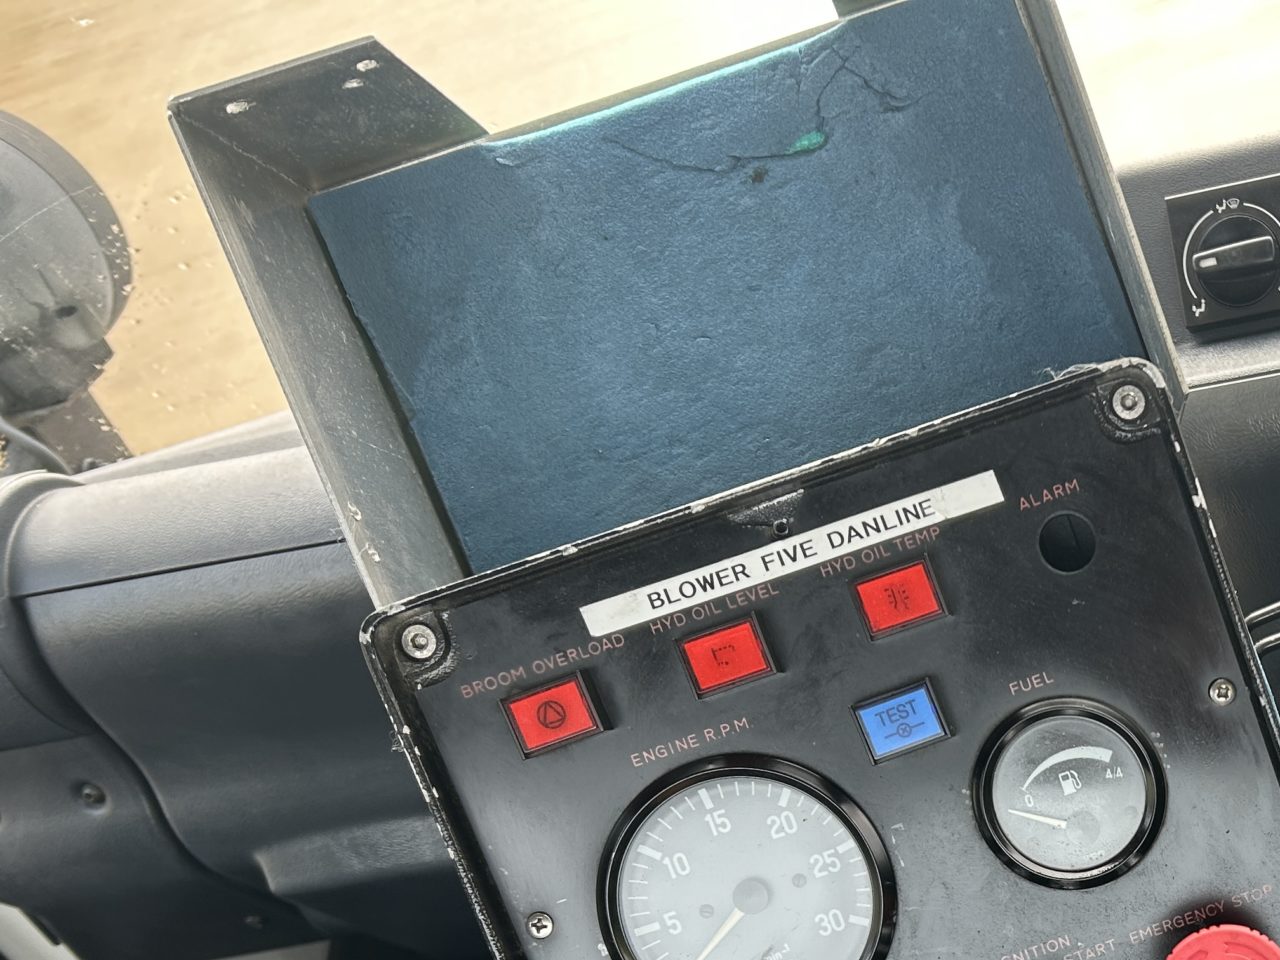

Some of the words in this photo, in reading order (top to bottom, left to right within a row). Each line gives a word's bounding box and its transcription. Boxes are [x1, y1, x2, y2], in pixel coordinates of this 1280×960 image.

[1019, 478, 1081, 512] ALARM
[647, 565, 750, 611] BLOWER
[762, 538, 819, 573] FIVE
[826, 498, 936, 550] DANLINE
[820, 555, 857, 578] HYD
[861, 545, 891, 563] OIL
[892, 525, 941, 551] TEMP
[649, 612, 687, 636] HYD
[687, 601, 722, 621] OIL
[727, 583, 780, 609] LEVEL
[460, 668, 526, 699] BROOM
[532, 633, 625, 675] OVERLOAD
[1009, 670, 1054, 696] FUEL
[874, 699, 918, 729] TEST
[631, 735, 700, 768] ENGINE
[703, 716, 753, 743] R.P.M.
[1025, 794, 1034, 808] 0
[704, 808, 732, 837] 15
[766, 810, 799, 840] 20
[662, 851, 692, 880] 10
[809, 848, 842, 879] 25
[663, 910, 682, 935] 5
[814, 908, 847, 937] 30
[1128, 900, 1226, 945] EMERGENCY
[1231, 884, 1273, 908] STOP
